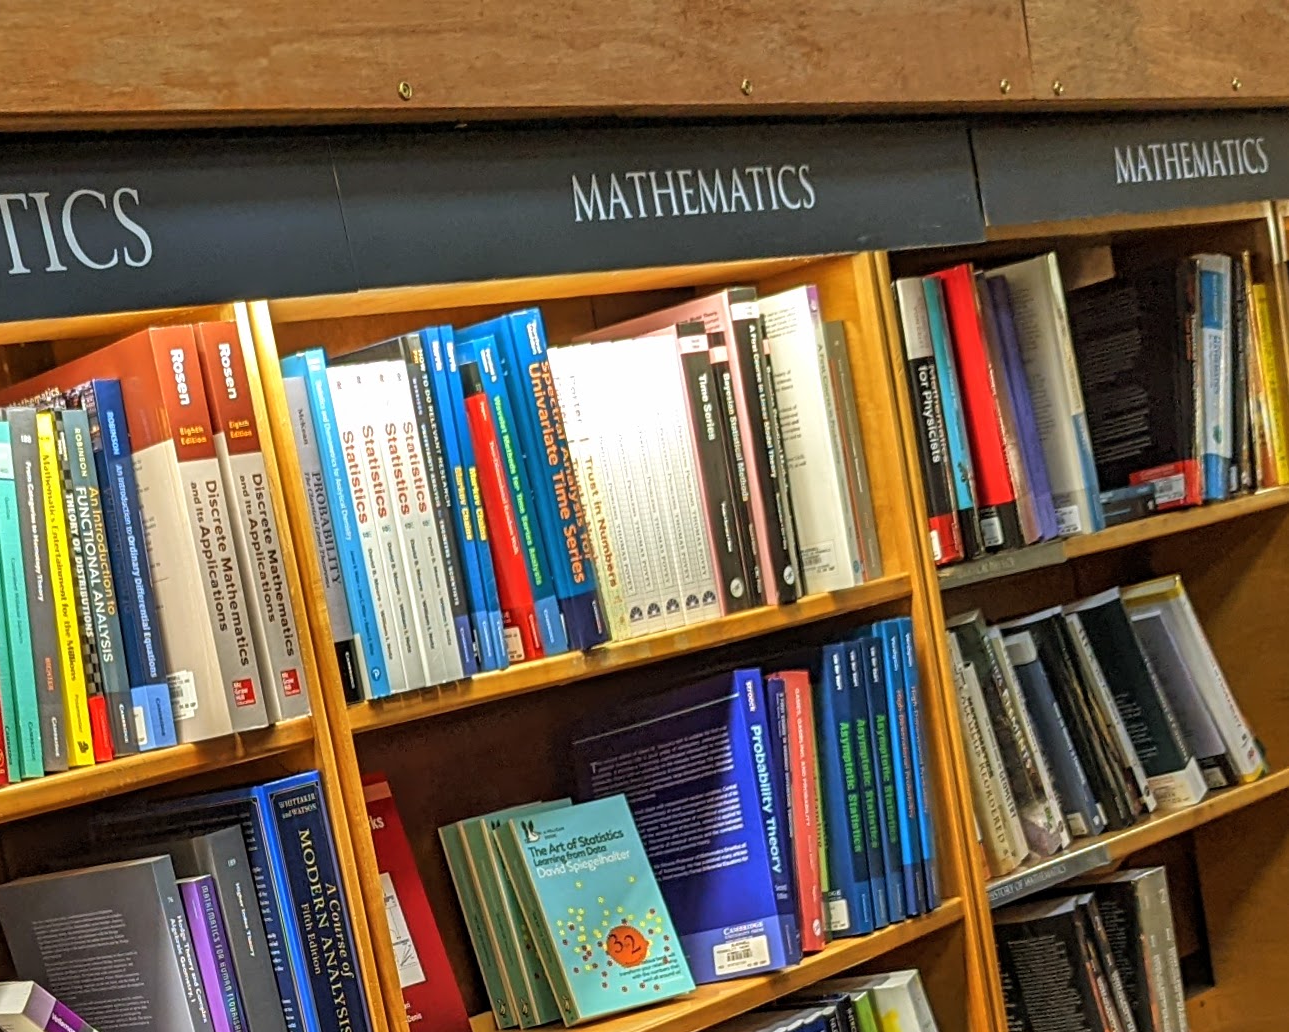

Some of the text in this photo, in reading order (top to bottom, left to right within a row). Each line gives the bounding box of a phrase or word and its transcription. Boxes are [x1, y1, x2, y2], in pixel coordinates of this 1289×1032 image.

[571, 164, 815, 222] MATHEMATICS
[1114, 137, 1268, 185] MATHEMATICS
[170, 348, 190, 405] Rosen
[219, 343, 237, 399] Rosen
[699, 372, 716, 441] Time Series
[918, 365, 940, 463] for Physicists
[342, 430, 368, 524] Statistics
[362, 425, 387, 519] Statistics
[528, 363, 585, 583] Univariate Time Series
[191, 481, 227, 632] and Its Applications
[312, 472, 341, 584] PROBABILITY
[585, 456, 617, 588] Trust in Numbers
[75, 486, 113, 663] FUNCTIONAL ANALYSIS
[205, 480, 249, 666] Discrete Mathematics
[528, 829, 624, 859] The Art of Statistics
[750, 724, 782, 874] Probability Theory
[298, 828, 330, 929] MODERN
[536, 850, 631, 878] David Spiegelhalter
